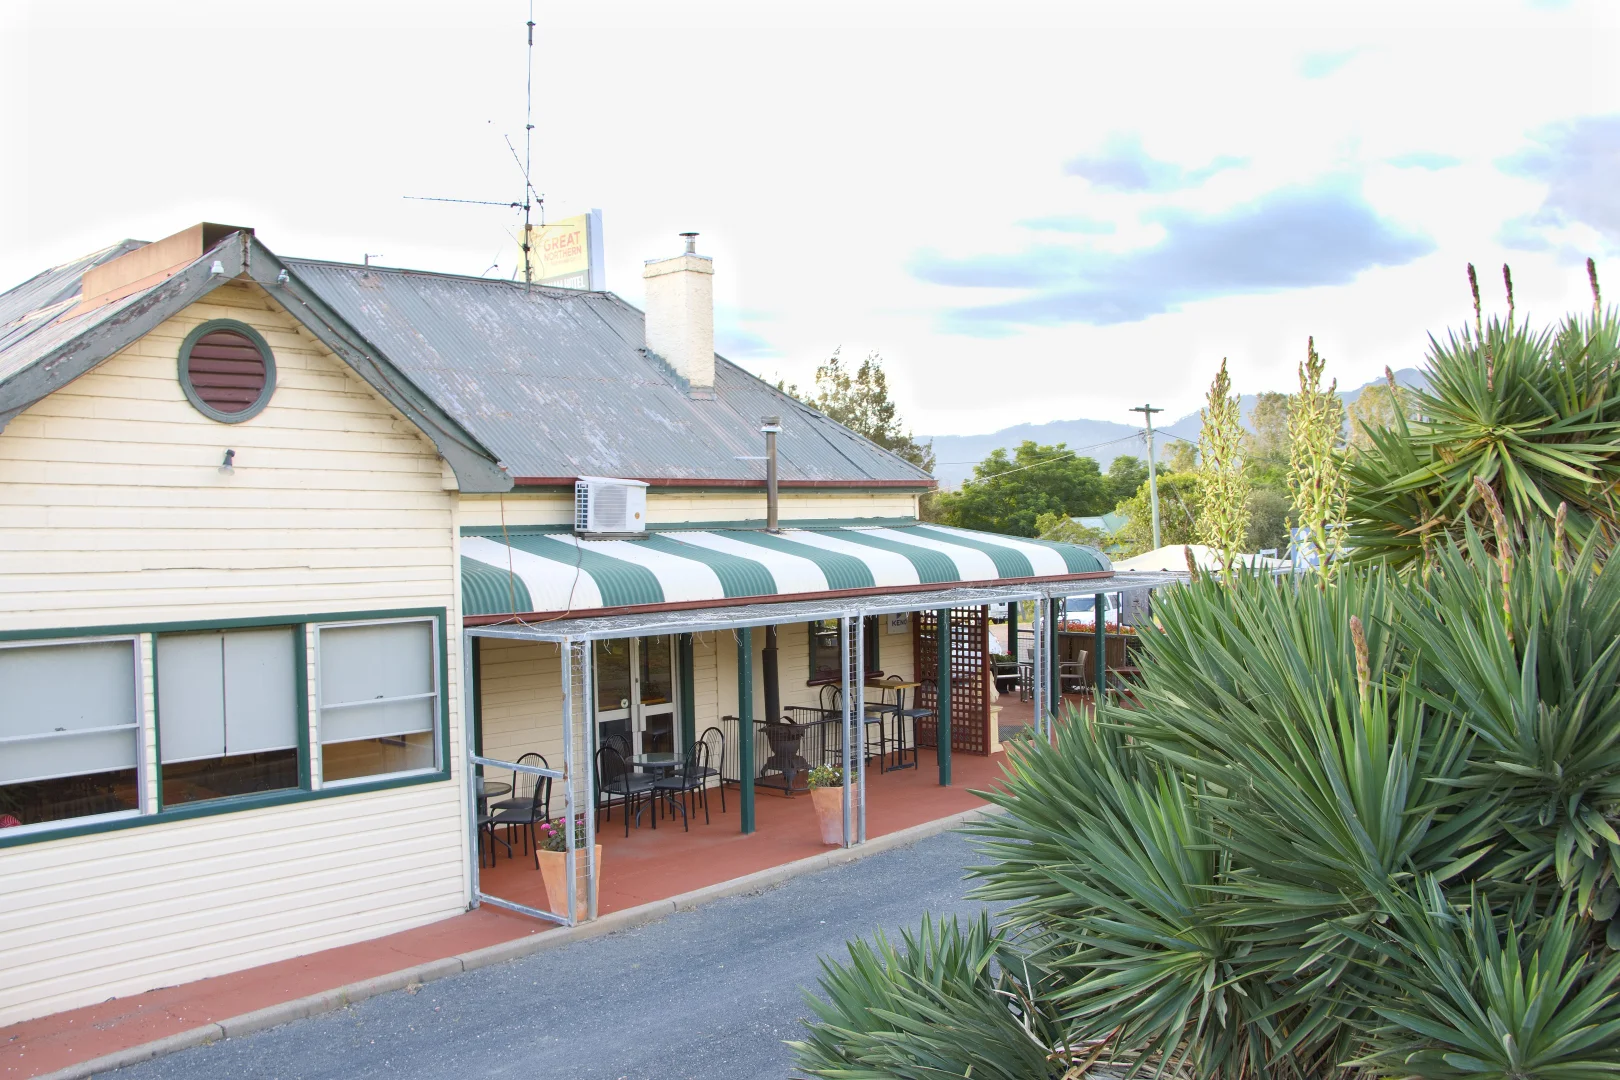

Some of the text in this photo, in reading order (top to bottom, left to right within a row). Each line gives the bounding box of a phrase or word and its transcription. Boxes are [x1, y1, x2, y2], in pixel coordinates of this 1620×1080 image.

[544, 231, 581, 251] GREAT
[544, 245, 582, 261] NORTHERN
[892, 618, 908, 627] KENO
